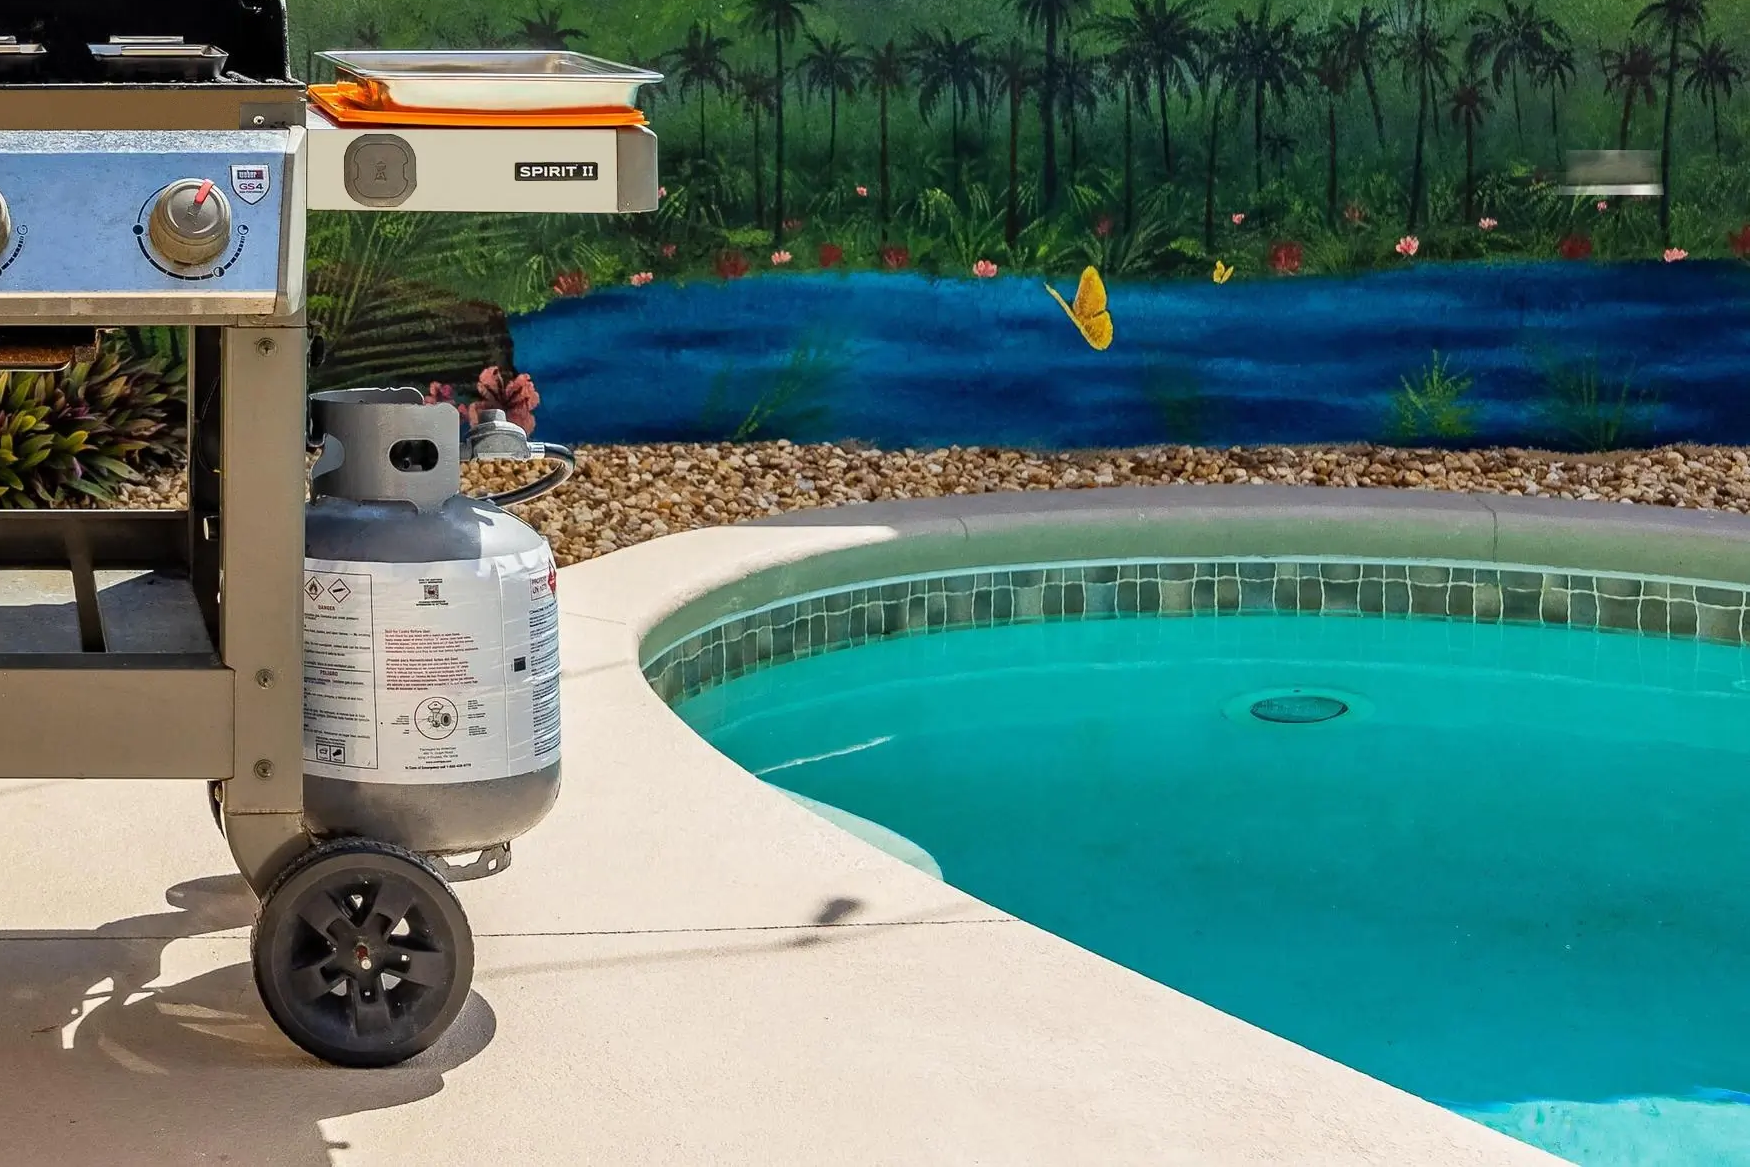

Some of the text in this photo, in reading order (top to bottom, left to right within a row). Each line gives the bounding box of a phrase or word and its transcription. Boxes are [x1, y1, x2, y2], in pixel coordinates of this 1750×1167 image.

[520, 166, 594, 177] SPIRIT II
[239, 182, 263, 190] GS4
